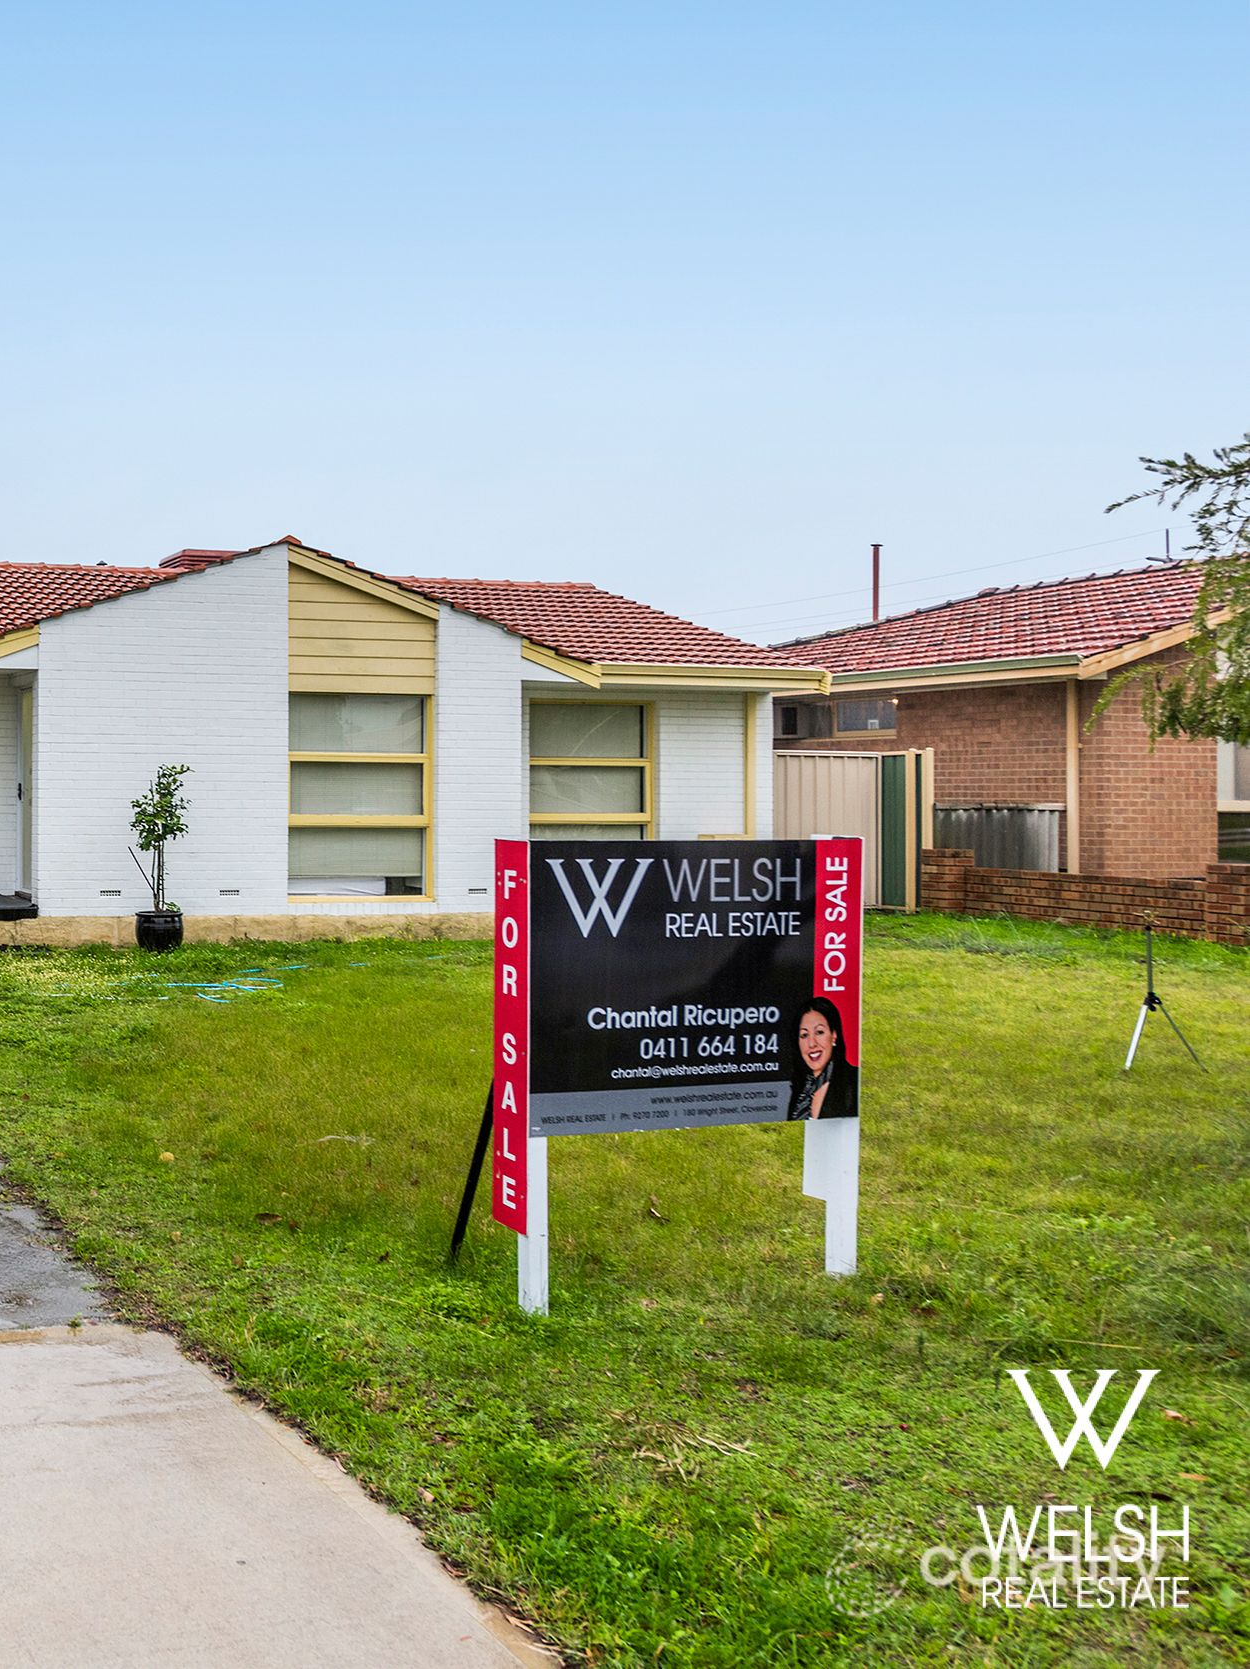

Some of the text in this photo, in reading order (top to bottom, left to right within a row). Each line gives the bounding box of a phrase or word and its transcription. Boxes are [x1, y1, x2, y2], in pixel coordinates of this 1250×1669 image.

[662, 857, 801, 902] WELSH
[665, 911, 801, 938] REAL ESTATE
[823, 856, 849, 992] FOR SALE
[587, 1004, 780, 1029] Chantal Ricupero
[501, 869, 519, 1210] FOR SALE
[639, 1033, 779, 1060] 0411 664 184
[611, 1062, 779, 1080] chantal@welshrealestate.com.au
[650, 1090, 779, 1105] www.welshrealestate.com.au
[541, 1115, 565, 1125] WELSH
[566, 1114, 583, 1124] REAL
[585, 1113, 606, 1123] ESTATE
